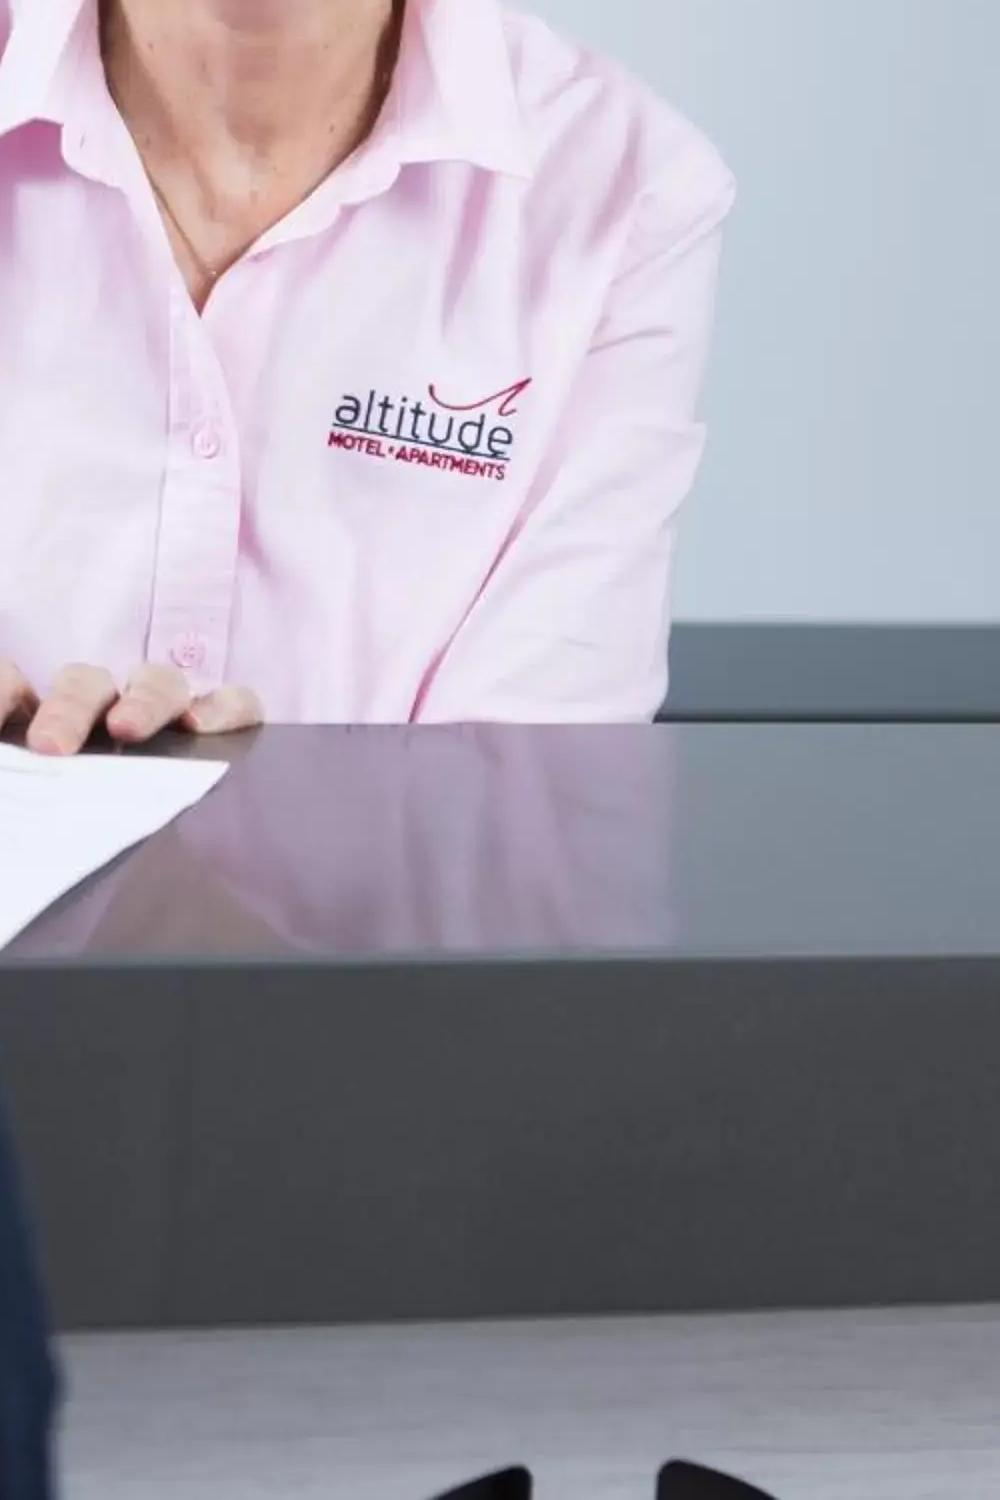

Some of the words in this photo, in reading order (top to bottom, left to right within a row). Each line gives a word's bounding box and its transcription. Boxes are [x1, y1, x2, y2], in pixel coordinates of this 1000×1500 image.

[334, 389, 514, 458] altitude
[327, 431, 386, 458] MOTEL
[396, 445, 506, 481] APARTMENTS
